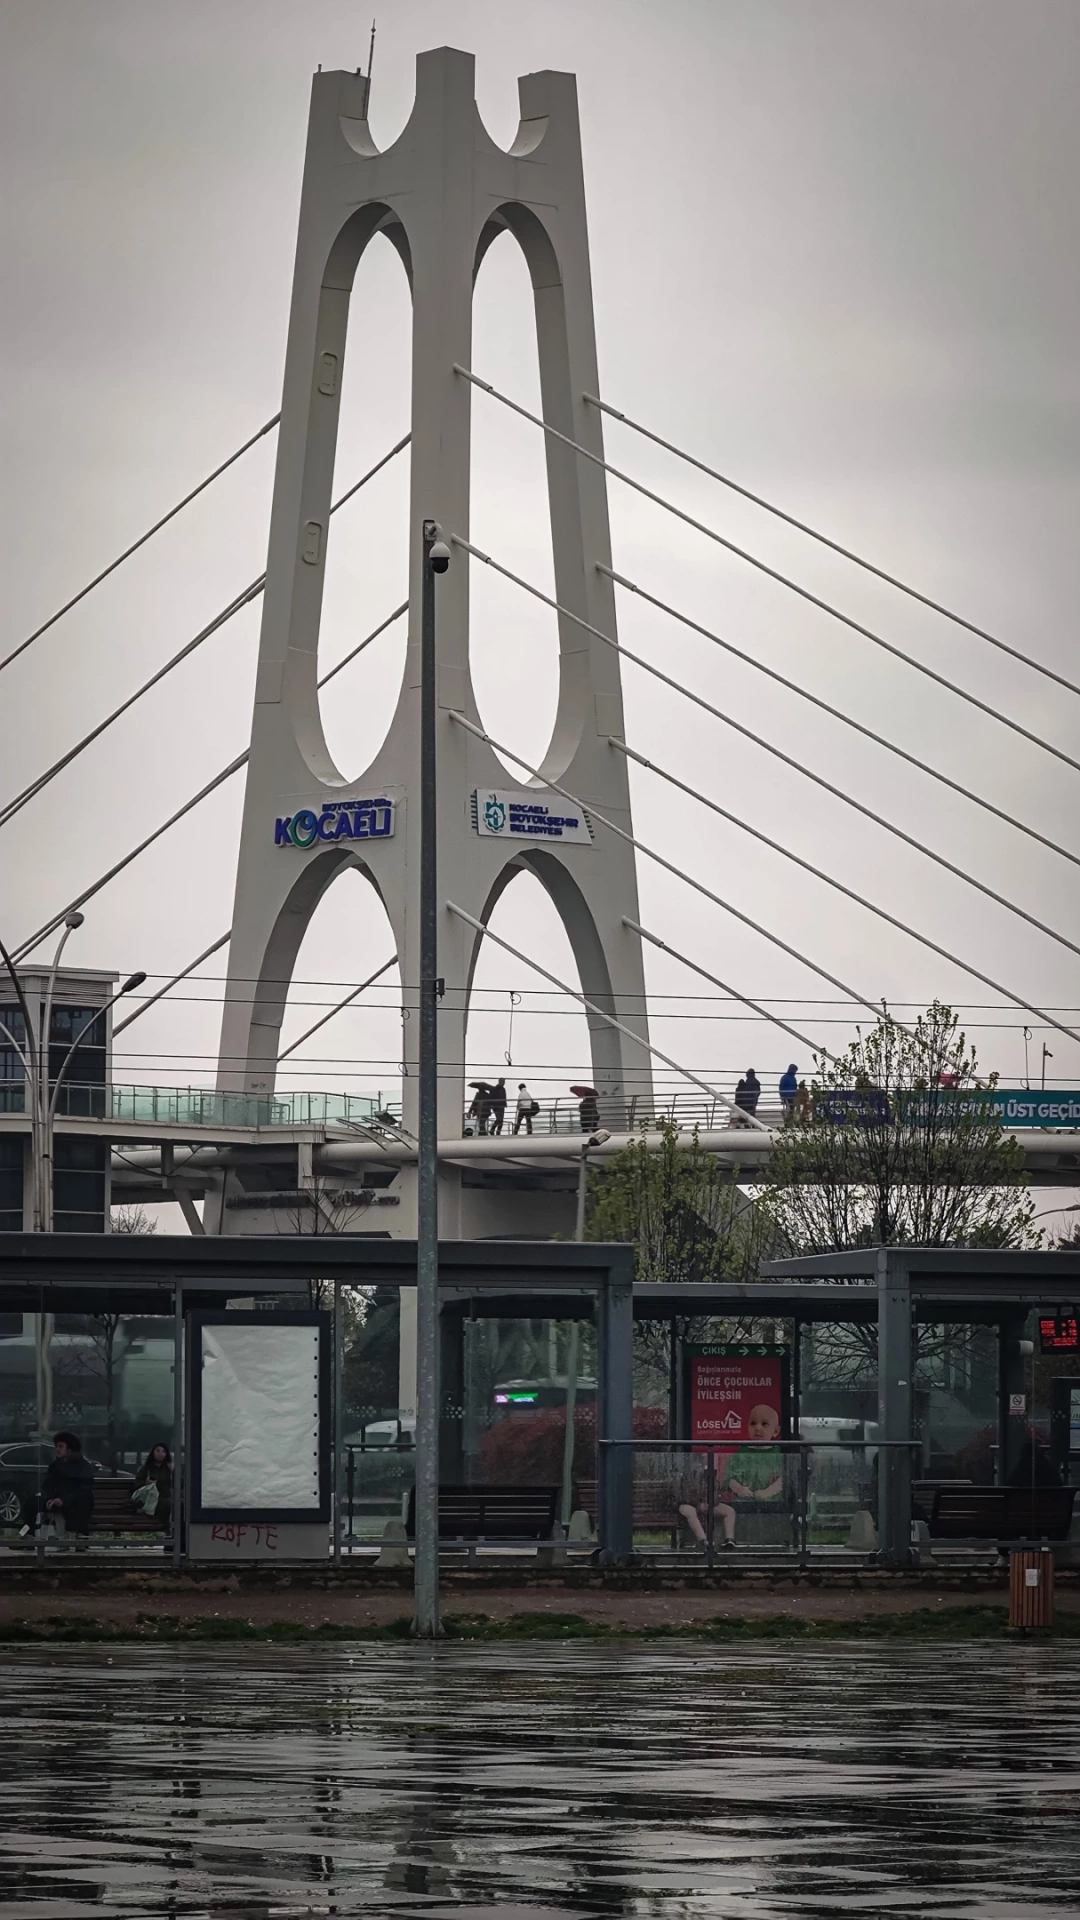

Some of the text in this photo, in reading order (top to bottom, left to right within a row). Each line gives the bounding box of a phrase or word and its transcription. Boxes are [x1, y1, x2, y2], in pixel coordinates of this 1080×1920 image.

[1007, 1099, 1037, 1118] ÜST
[702, 1346, 727, 1356] ÇIKIŞ
[697, 1375, 772, 1389] ÖNCE ÇOCUKLAR
[697, 1389, 742, 1402] İYİLEŞSİN
[697, 1419, 728, 1429] LÖSEV
